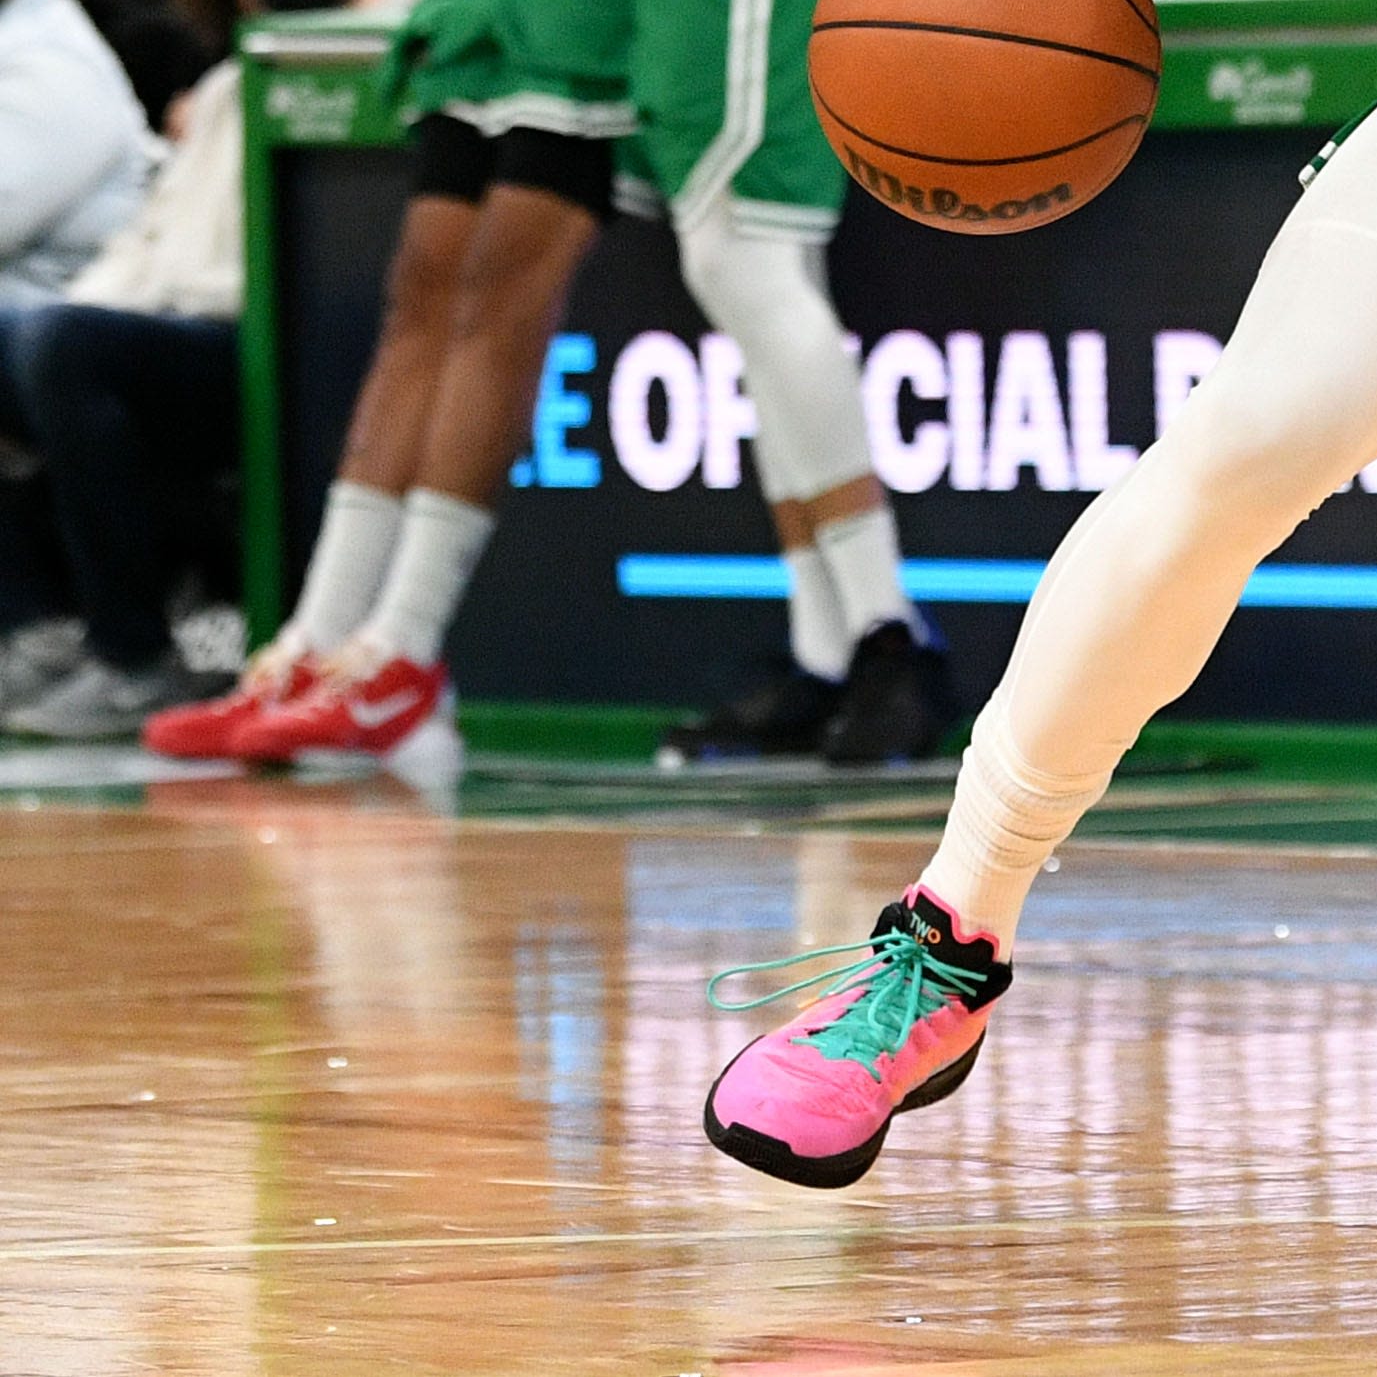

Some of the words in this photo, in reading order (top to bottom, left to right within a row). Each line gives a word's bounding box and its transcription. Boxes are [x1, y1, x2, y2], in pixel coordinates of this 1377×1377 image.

[843, 142, 1073, 222] Wilson
[608, 329, 1142, 494] OFCIAL
[909, 911, 941, 944] TWO
